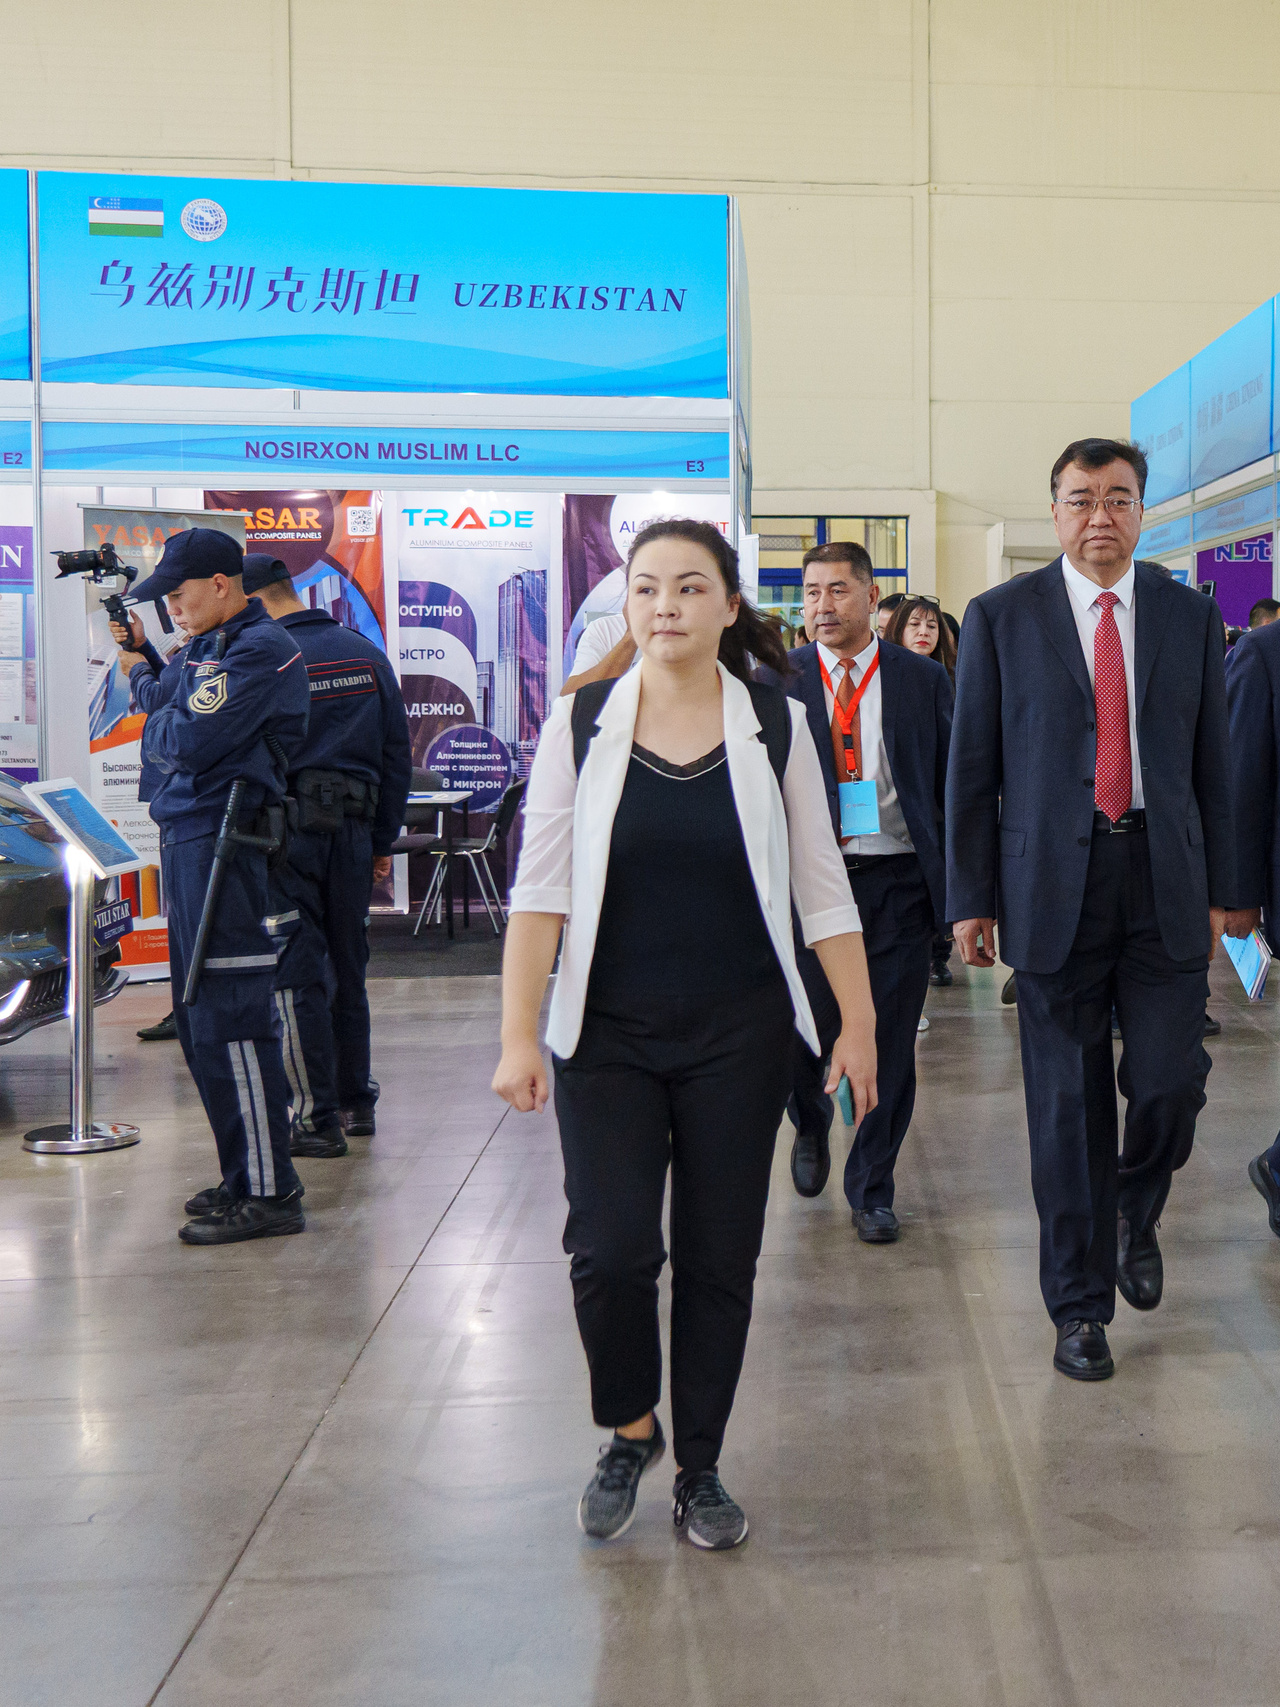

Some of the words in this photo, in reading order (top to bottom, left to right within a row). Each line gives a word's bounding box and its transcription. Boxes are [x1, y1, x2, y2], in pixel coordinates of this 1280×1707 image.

[91, 259, 421, 317] 乌兹别克斯坦
[454, 282, 688, 313] UZBEKISTAN
[244, 441, 369, 460] NOSIRXON
[377, 442, 468, 461] MUSLIM
[477, 443, 520, 462] LLC
[3, 452, 23, 465] E2
[686, 461, 705, 473] E3
[401, 506, 535, 530] TRADE
[254, 532, 296, 540] COMPOSITE
[296, 532, 322, 540] PANELS
[410, 539, 455, 547] ALUMINIUM
[456, 540, 503, 548] COMPOSITE
[504, 541, 533, 549] PANELS
[399, 605, 463, 617] ОСТУПНО
[333, 673, 373, 689] GVARDIYA
[449, 740, 488, 749] Толщина
[436, 751, 501, 760] Алюминиевого
[459, 764, 508, 773] покрытием
[442, 778, 450, 789] 8
[453, 780, 502, 791] микрон
[96, 910, 112, 929] YILI
[112, 902, 130, 924] STAR
